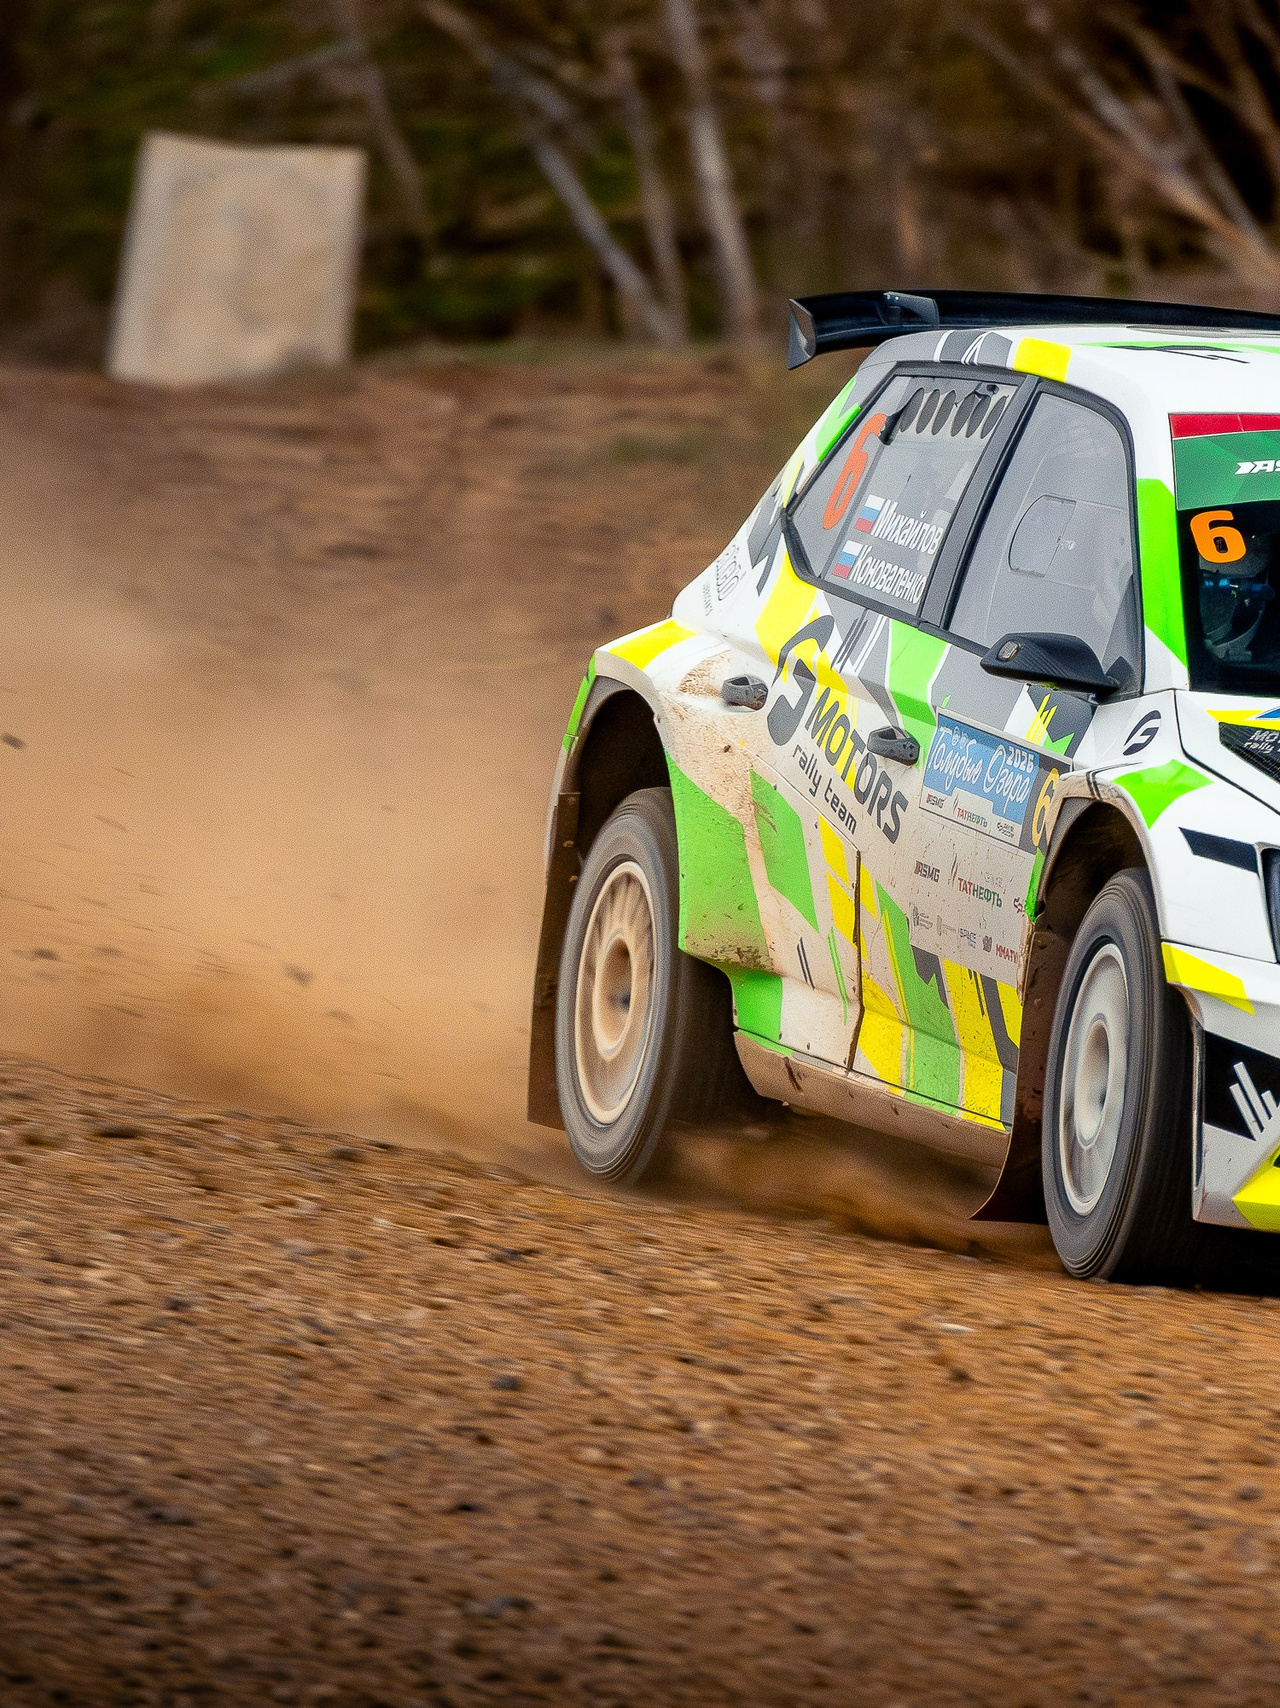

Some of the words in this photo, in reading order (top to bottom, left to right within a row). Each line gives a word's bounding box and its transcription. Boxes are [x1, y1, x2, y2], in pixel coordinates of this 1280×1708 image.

[822, 412, 888, 531] 6
[870, 499, 944, 555] Михайлов
[1189, 509, 1247, 564] 6
[848, 544, 928, 604] Коноваленко
[804, 687, 910, 845] MOTORS
[1243, 741, 1275, 754] rally
[792, 744, 823, 797] rally
[824, 778, 858, 835] team
[957, 877, 1003, 908] ТАТНЕФТЬ
